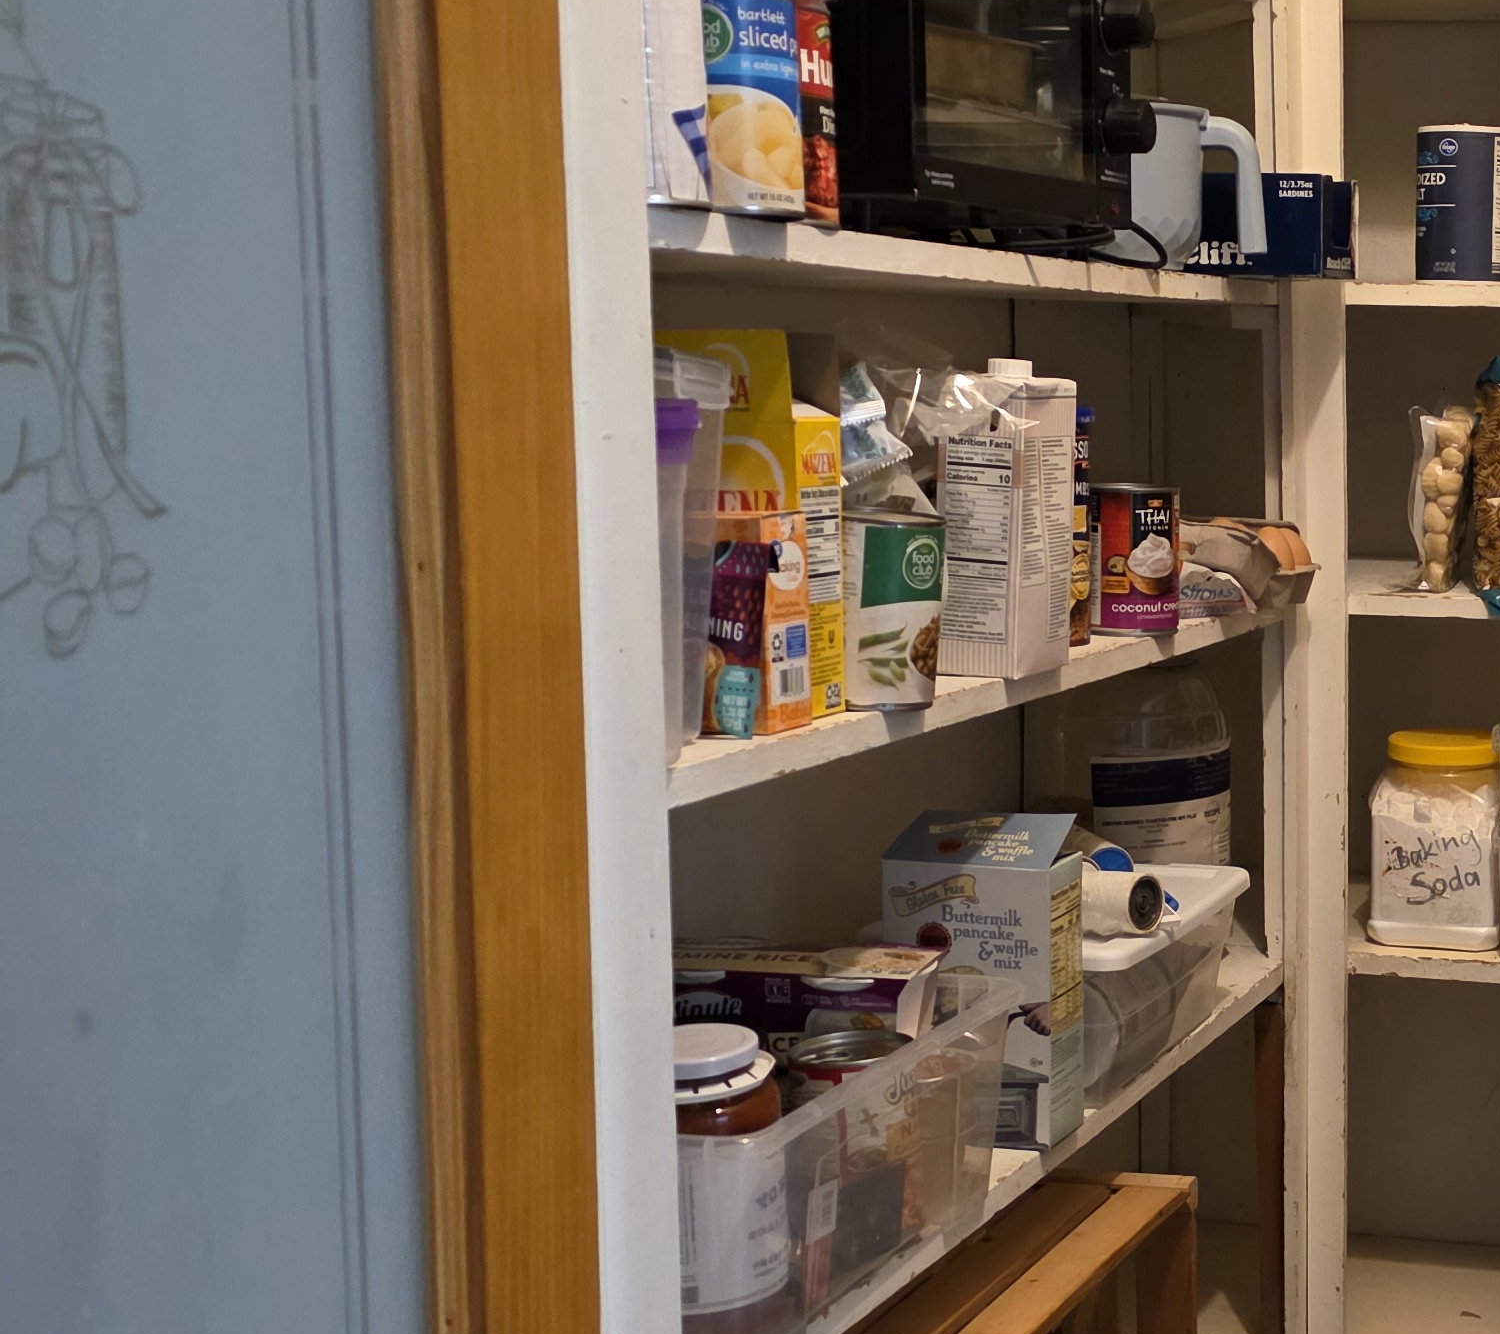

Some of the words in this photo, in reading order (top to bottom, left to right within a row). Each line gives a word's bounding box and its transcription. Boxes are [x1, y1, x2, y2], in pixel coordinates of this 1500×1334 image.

[737, 6, 787, 25] bartlett
[702, 20, 721, 34] od
[703, 37, 720, 48] ub
[738, 25, 788, 51] sliced
[1278, 189, 1314, 198] SARDINES
[948, 435, 987, 448] Nutrition
[989, 439, 1013, 450] Facts
[946, 472, 978, 482] Calories
[999, 474, 1011, 484] 10
[1075, 481, 1090, 496] MBS
[1135, 508, 1170, 525] THAI
[912, 551, 934, 564] food
[912, 564, 933, 576] club
[1111, 601, 1161, 614] coconut
[965, 828, 1031, 841] Buttermilk
[967, 838, 1020, 848] pancake
[1390, 828, 1483, 871] Baking
[981, 845, 996, 857] &
[997, 846, 1034, 857] waffle
[991, 853, 1016, 862] mix
[1406, 865, 1481, 906] Soda
[906, 889, 940, 910] Gluten
[943, 882, 966, 896] Free
[941, 903, 1023, 927] Buttermilk
[953, 925, 1015, 942] pancake
[978, 940, 993, 961] &
[993, 939, 1039, 959] waffle
[753, 953, 813, 964] RICE
[993, 957, 1022, 970] mix
